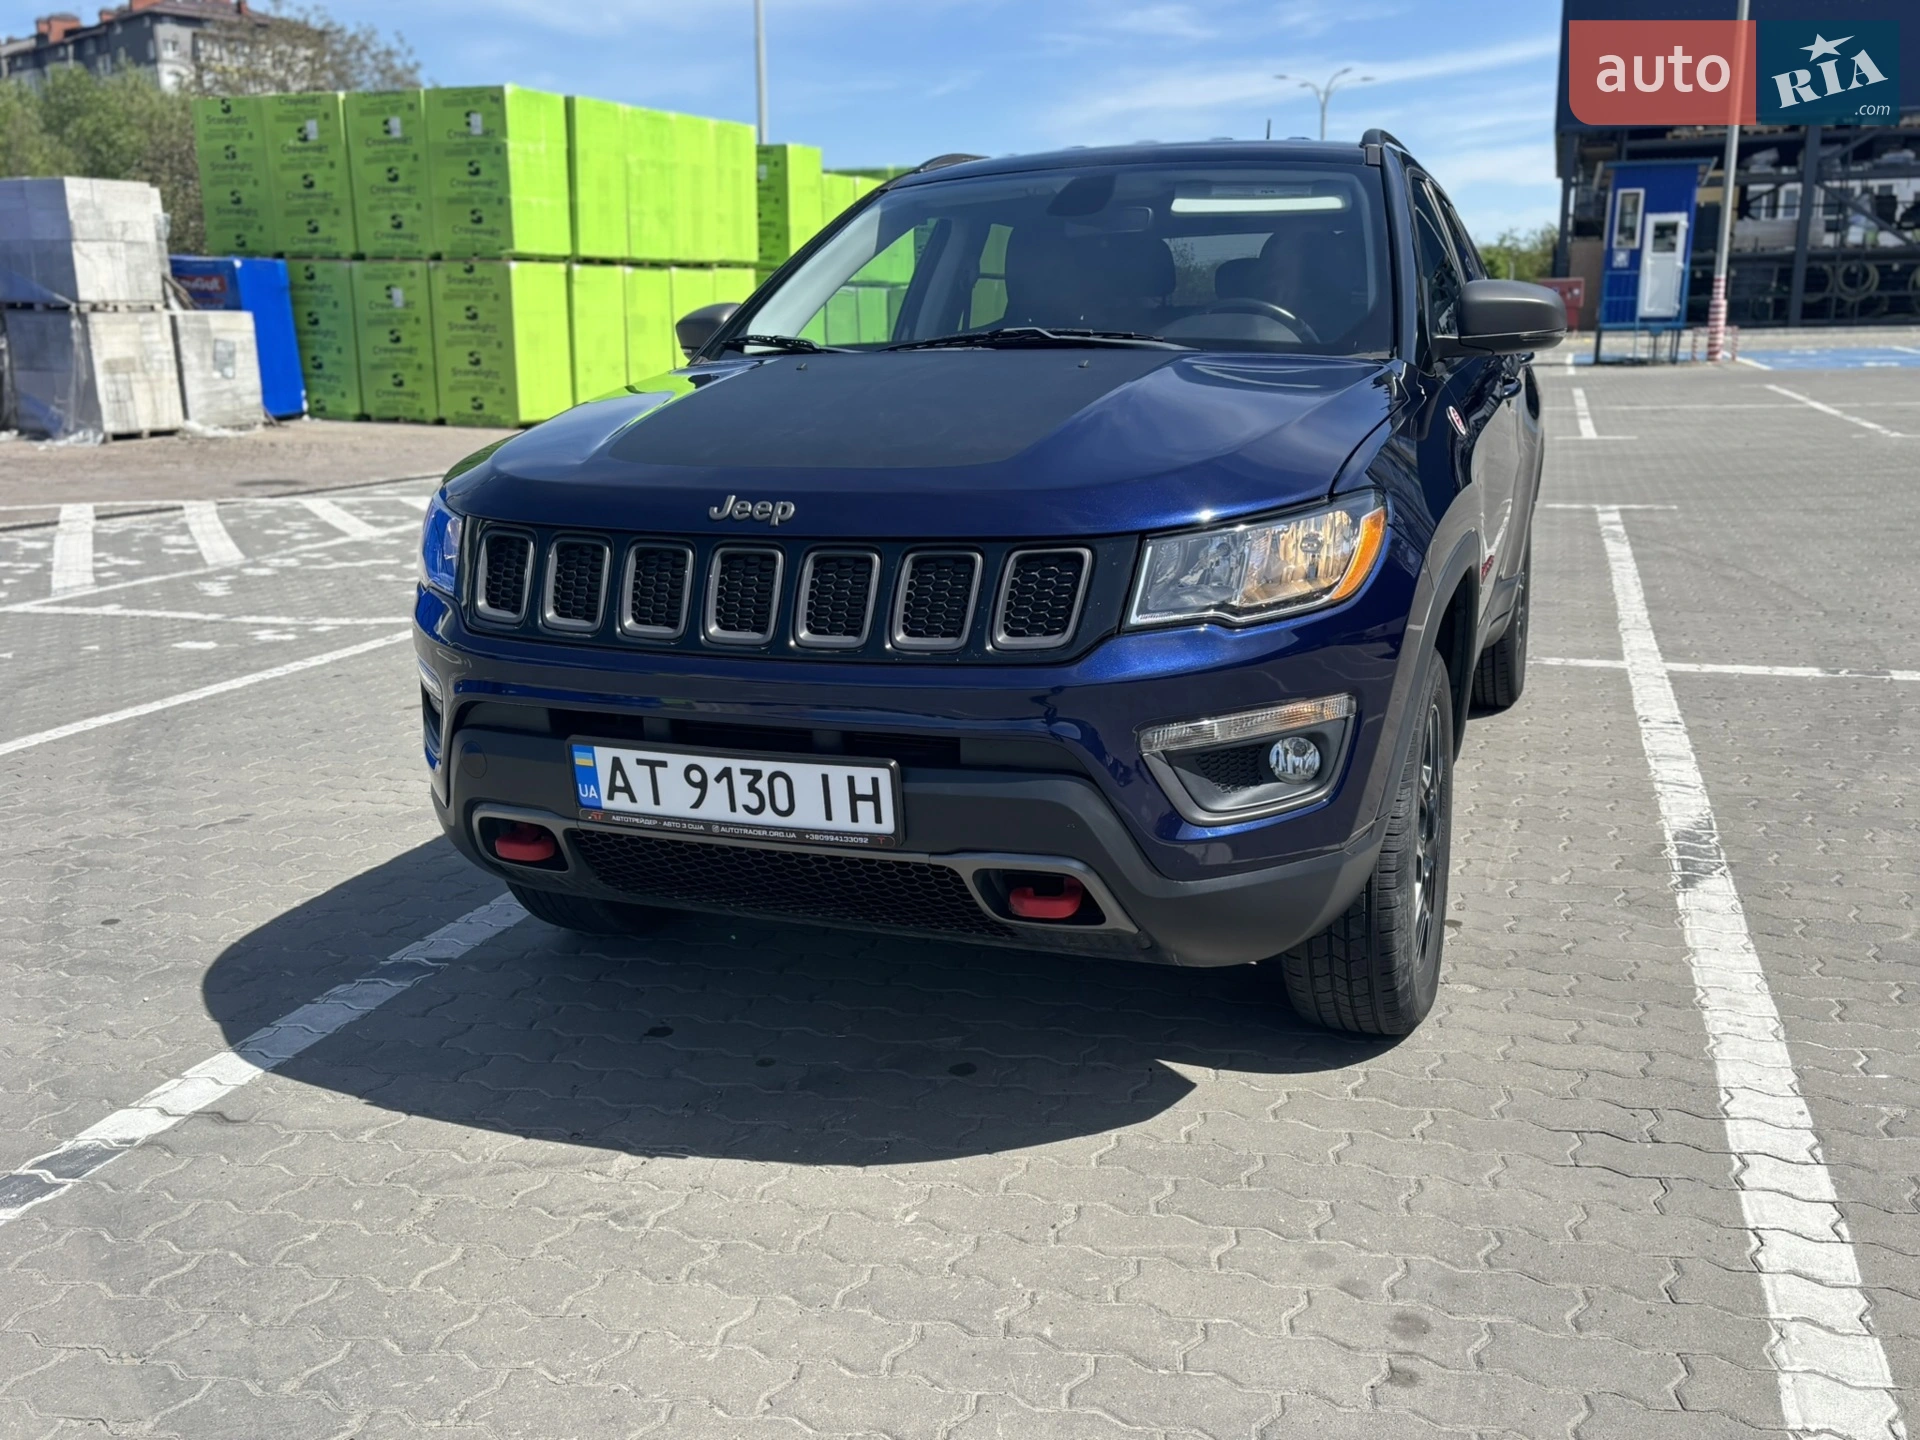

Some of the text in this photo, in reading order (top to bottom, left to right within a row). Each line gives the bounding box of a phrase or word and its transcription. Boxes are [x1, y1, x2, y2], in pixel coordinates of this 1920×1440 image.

[708, 494, 796, 527] Jeep
[578, 784, 598, 799] UA
[606, 756, 883, 824] AT 9130 IH
